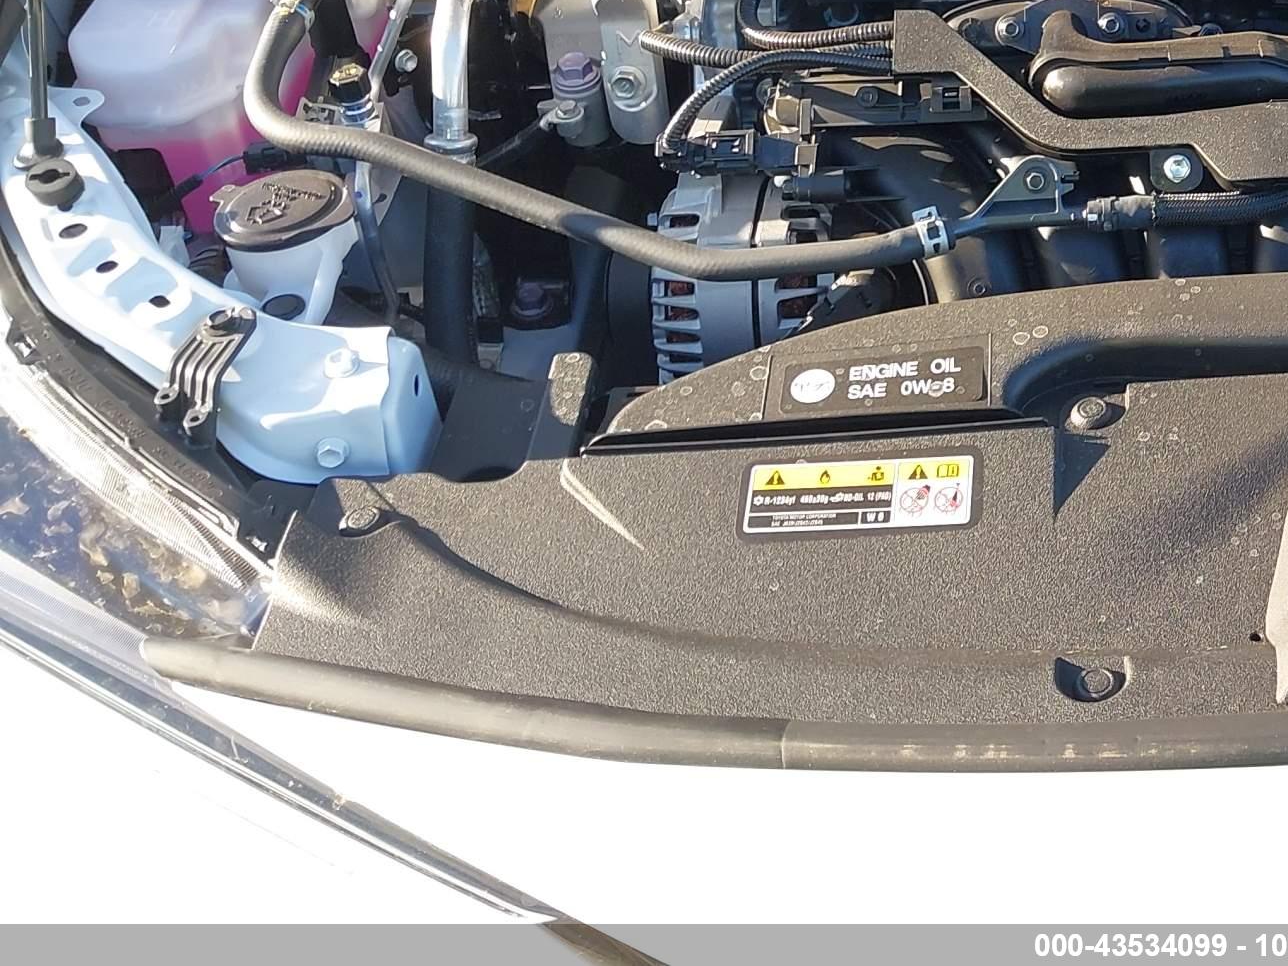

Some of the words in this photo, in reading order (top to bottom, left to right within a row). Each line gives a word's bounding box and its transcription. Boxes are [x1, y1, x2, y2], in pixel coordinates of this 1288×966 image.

[848, 360, 919, 381] ENGINE
[930, 356, 962, 374] OIL
[847, 382, 887, 399] SAE
